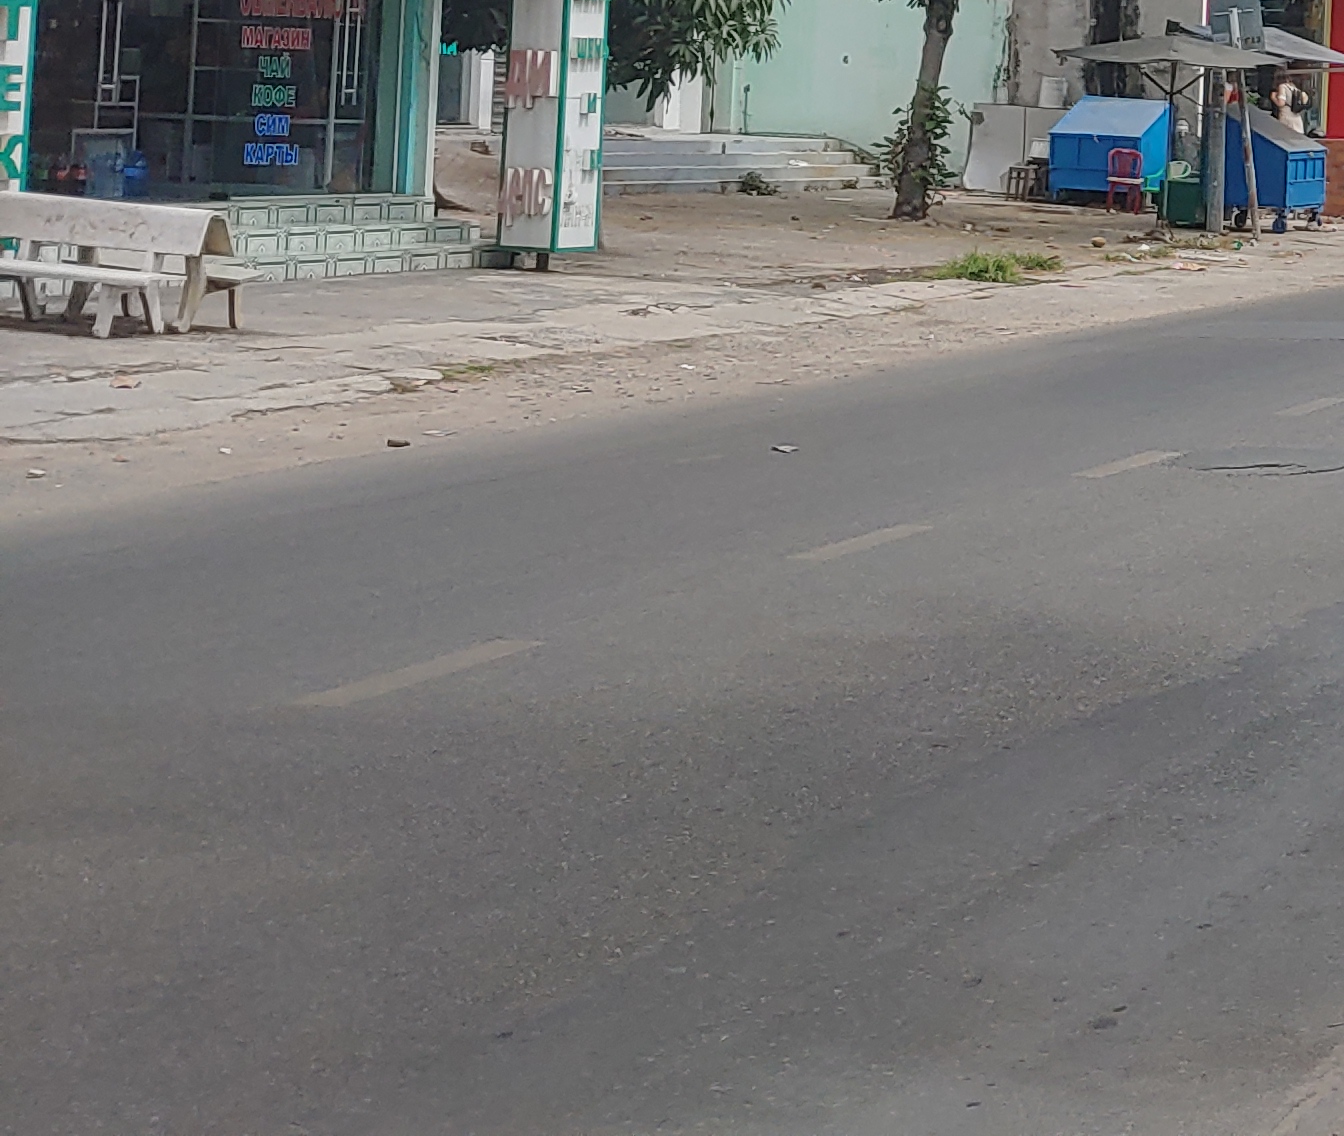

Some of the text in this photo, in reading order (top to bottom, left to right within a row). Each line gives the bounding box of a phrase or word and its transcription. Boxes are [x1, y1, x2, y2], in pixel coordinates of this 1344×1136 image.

[242, 25, 310, 50] МАГАЗИН
[258, 52, 291, 78] ЧАЙ
[252, 84, 296, 107] КОФЕ
[254, 114, 290, 136] СИМ
[243, 143, 299, 165] КАРТЫ
